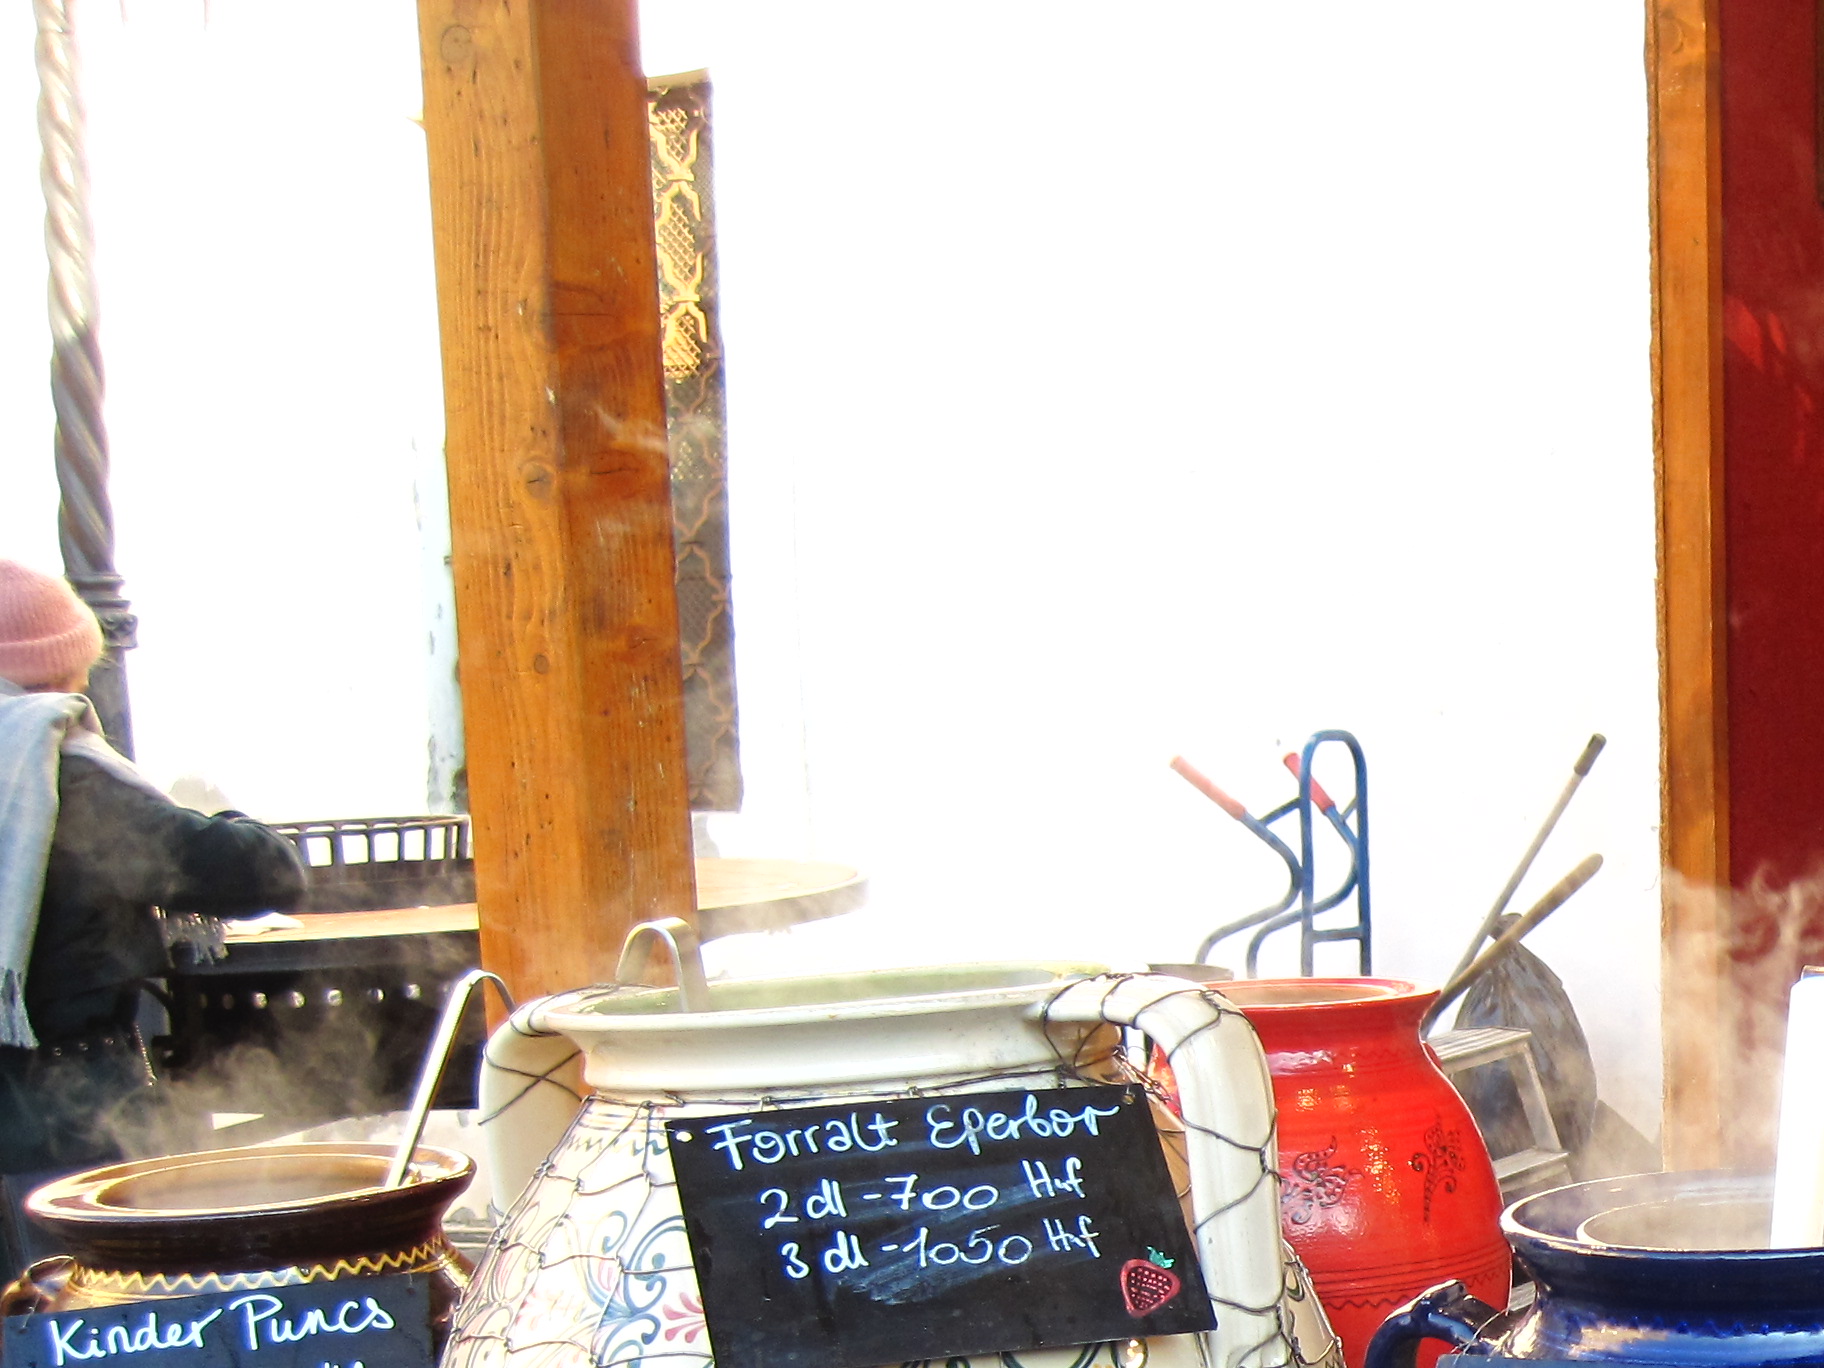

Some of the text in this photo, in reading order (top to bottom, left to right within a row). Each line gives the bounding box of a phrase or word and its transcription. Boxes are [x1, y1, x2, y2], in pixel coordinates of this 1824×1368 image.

[706, 1095, 1120, 1171] Forralt Eperbor
[761, 1188, 798, 1229] 2
[806, 1178, 846, 1219] dl
[1023, 1157, 1083, 1199] Huf
[781, 1244, 808, 1279] 3
[825, 1230, 868, 1273] dl
[1045, 1216, 1100, 1258] Huf
[49, 1294, 395, 1367] Kinder Puncs
